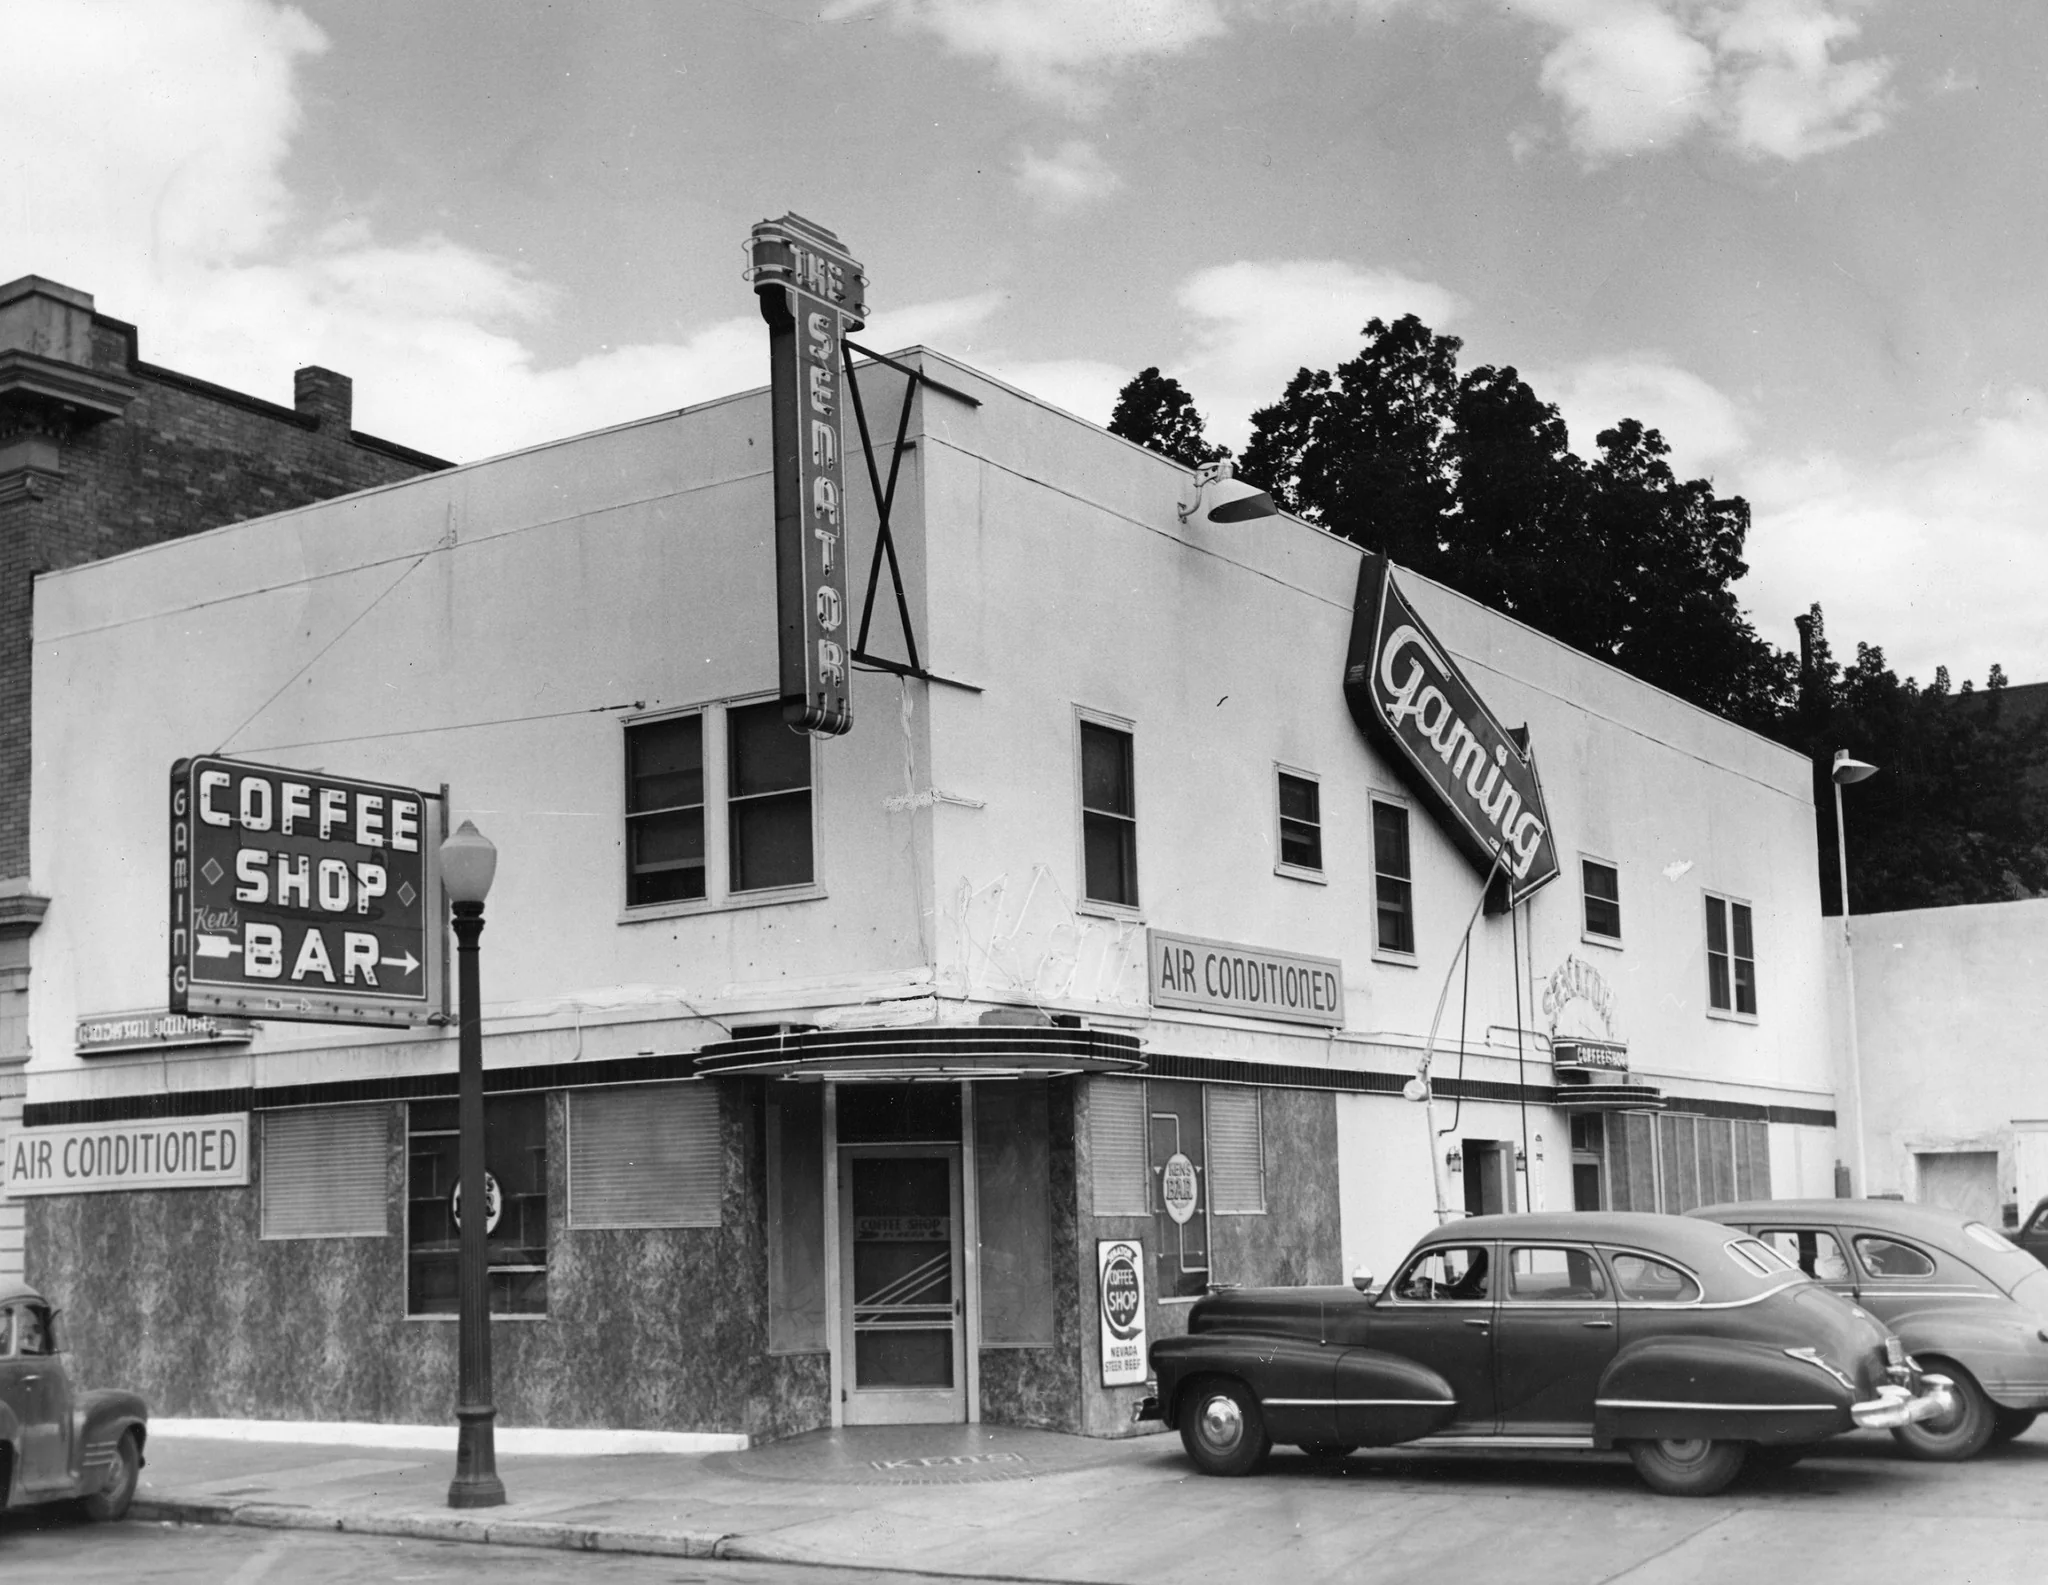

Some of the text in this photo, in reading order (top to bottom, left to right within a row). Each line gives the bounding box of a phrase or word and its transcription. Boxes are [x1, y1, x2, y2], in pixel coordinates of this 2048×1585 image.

[789, 243, 846, 303] THE
[808, 311, 844, 688] SENATOR
[1380, 624, 1546, 880] Gaming
[199, 770, 418, 853] COFFEE
[236, 848, 387, 914] SHOP
[194, 904, 238, 935] Ken's
[244, 922, 379, 986] BAR
[1161, 946, 1337, 1013] AIR CONDITIONED
[12, 1128, 237, 1180] AIR CONDITIONED
[1165, 1177, 1193, 1201] BAR
[860, 1217, 941, 1231] COFFEE SHOP
[1108, 1269, 1134, 1285] COFFEE
[1108, 1290, 1138, 1312] SHOP
[1104, 1358, 1141, 1373] STEER BEEF
[1110, 1345, 1138, 1358] NEVADA
